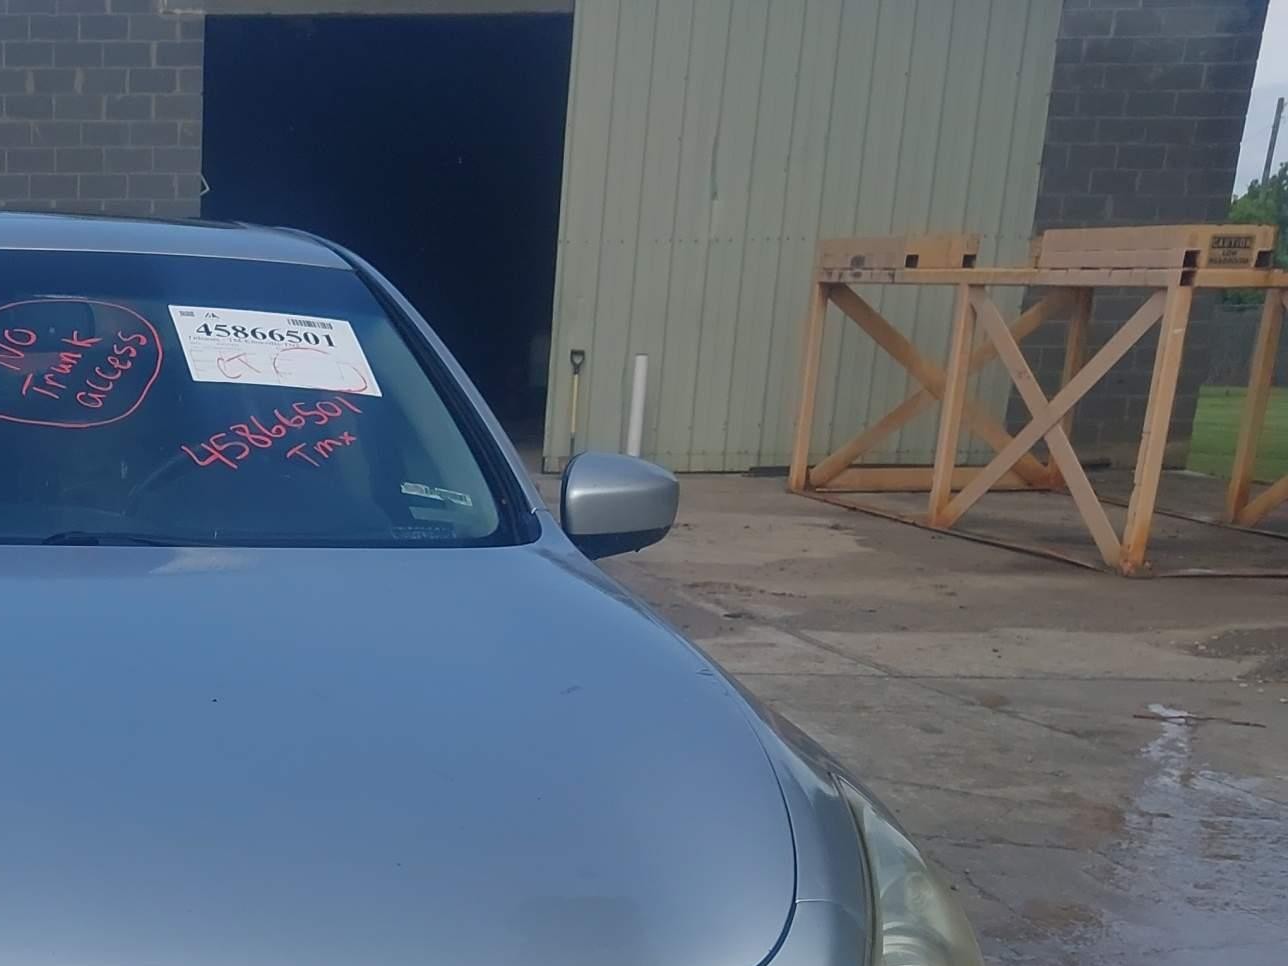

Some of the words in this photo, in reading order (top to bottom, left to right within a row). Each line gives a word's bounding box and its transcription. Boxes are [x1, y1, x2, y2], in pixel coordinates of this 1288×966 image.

[1212, 237, 1252, 248] CAUTION
[196, 322, 336, 348] 45866501
[21, 330, 103, 400] Trunk
[180, 396, 363, 470] 45866501
